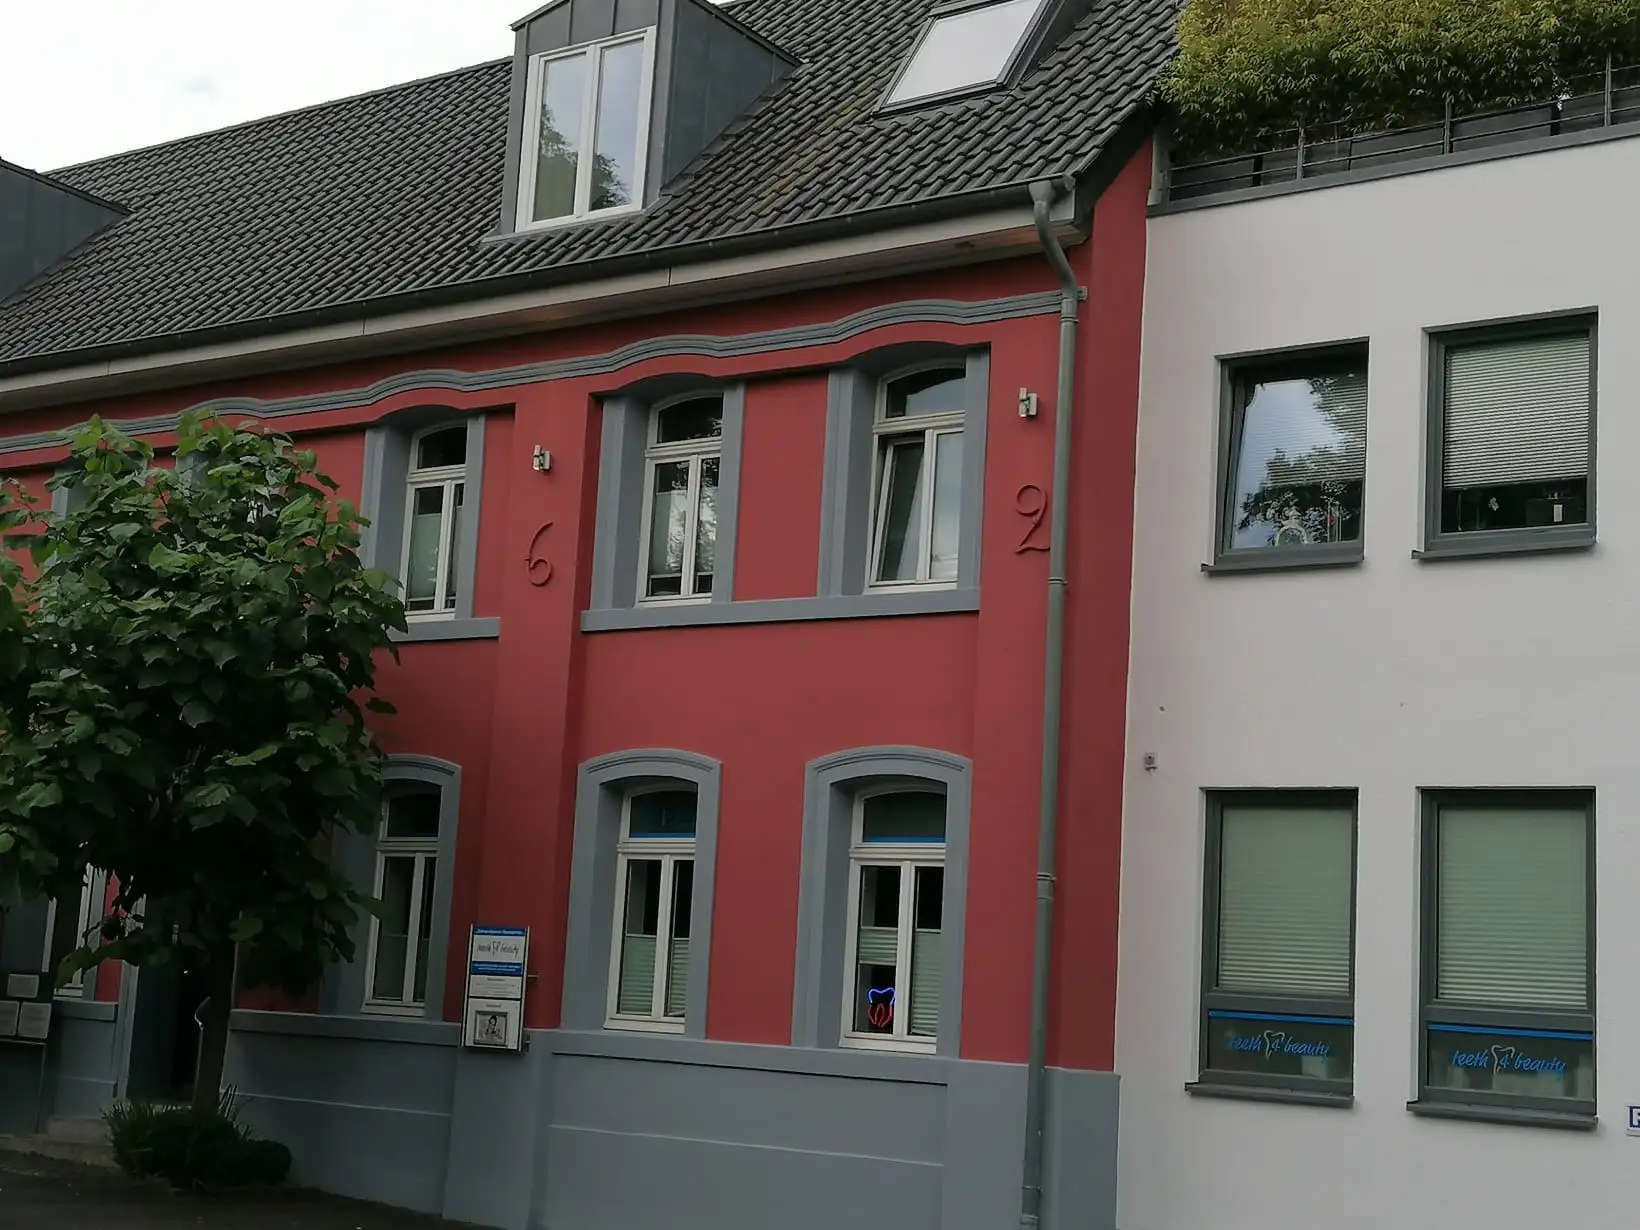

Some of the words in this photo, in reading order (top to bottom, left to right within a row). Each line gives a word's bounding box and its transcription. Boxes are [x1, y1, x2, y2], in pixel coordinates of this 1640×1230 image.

[1014, 484, 1051, 555] 2
[524, 520, 554, 587] 6
[1229, 1034, 1262, 1052] teeth
[1283, 1037, 1330, 1058] beauty
[1452, 1049, 1489, 1068] teeth
[1514, 1053, 1566, 1076] beauty
